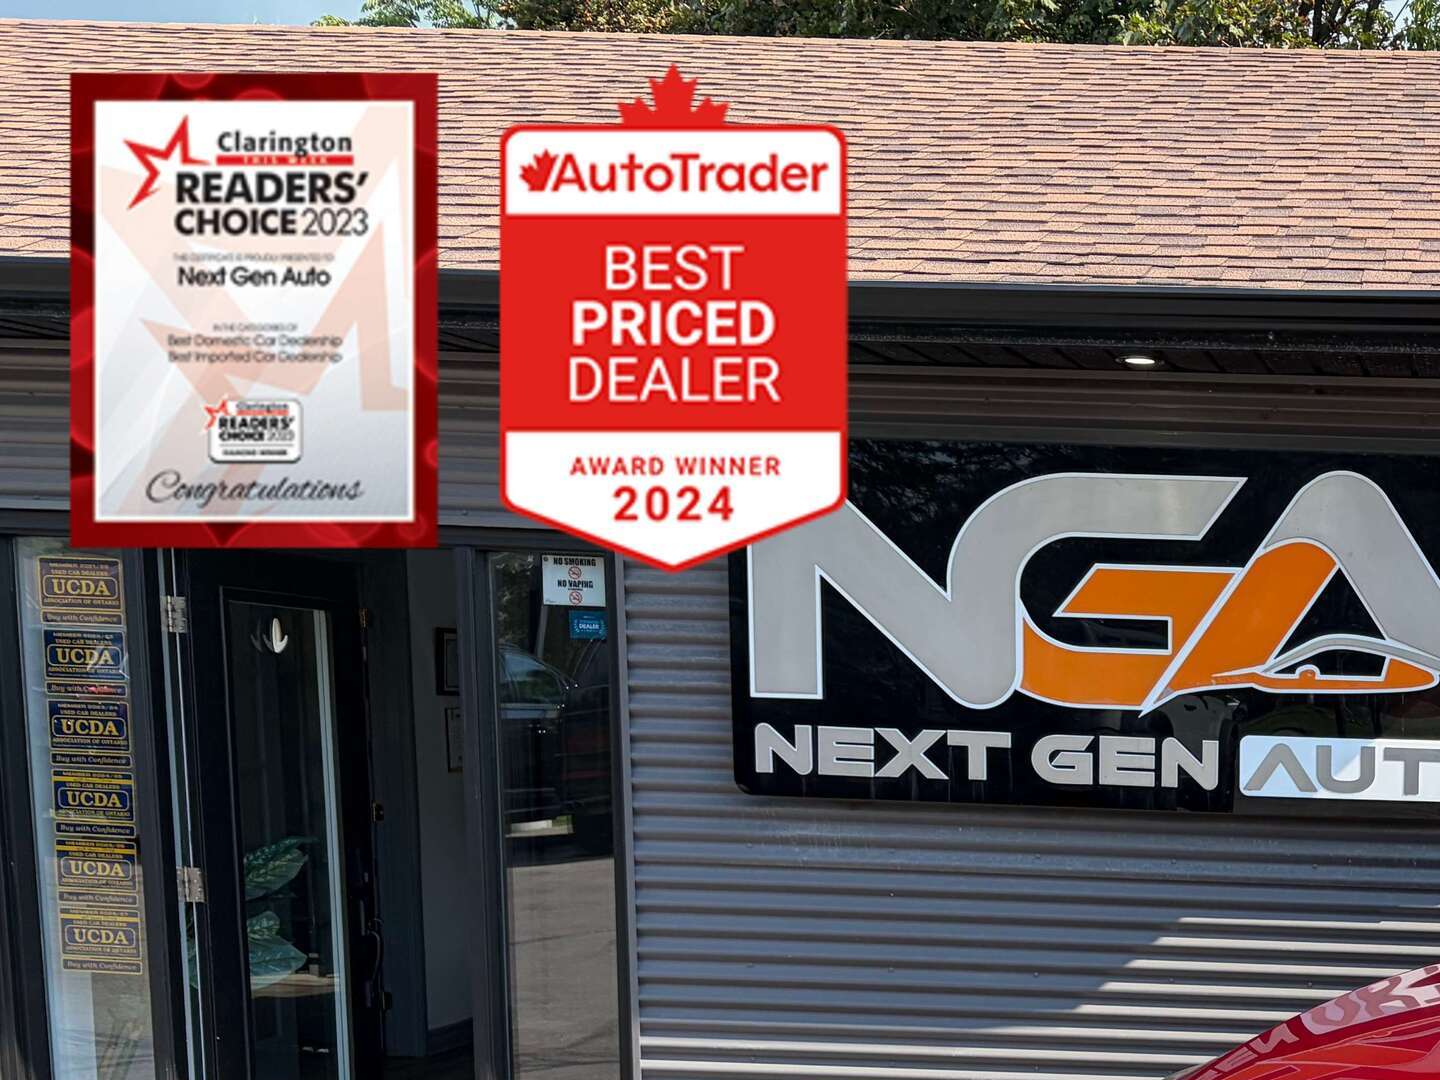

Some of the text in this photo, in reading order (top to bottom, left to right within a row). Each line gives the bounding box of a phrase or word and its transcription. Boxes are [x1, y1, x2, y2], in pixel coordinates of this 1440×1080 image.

[553, 557, 597, 567] NO SMOKING
[51, 578, 112, 596] UCDA
[557, 579, 594, 589] NO VAPING
[56, 648, 114, 665] UCDA
[60, 719, 120, 736] UCDA
[754, 722, 1011, 782] NEXT
[1030, 734, 1219, 791] GEN
[66, 791, 123, 807] UCDA
[68, 860, 125, 877] UCDA
[73, 928, 129, 945] UCDA
